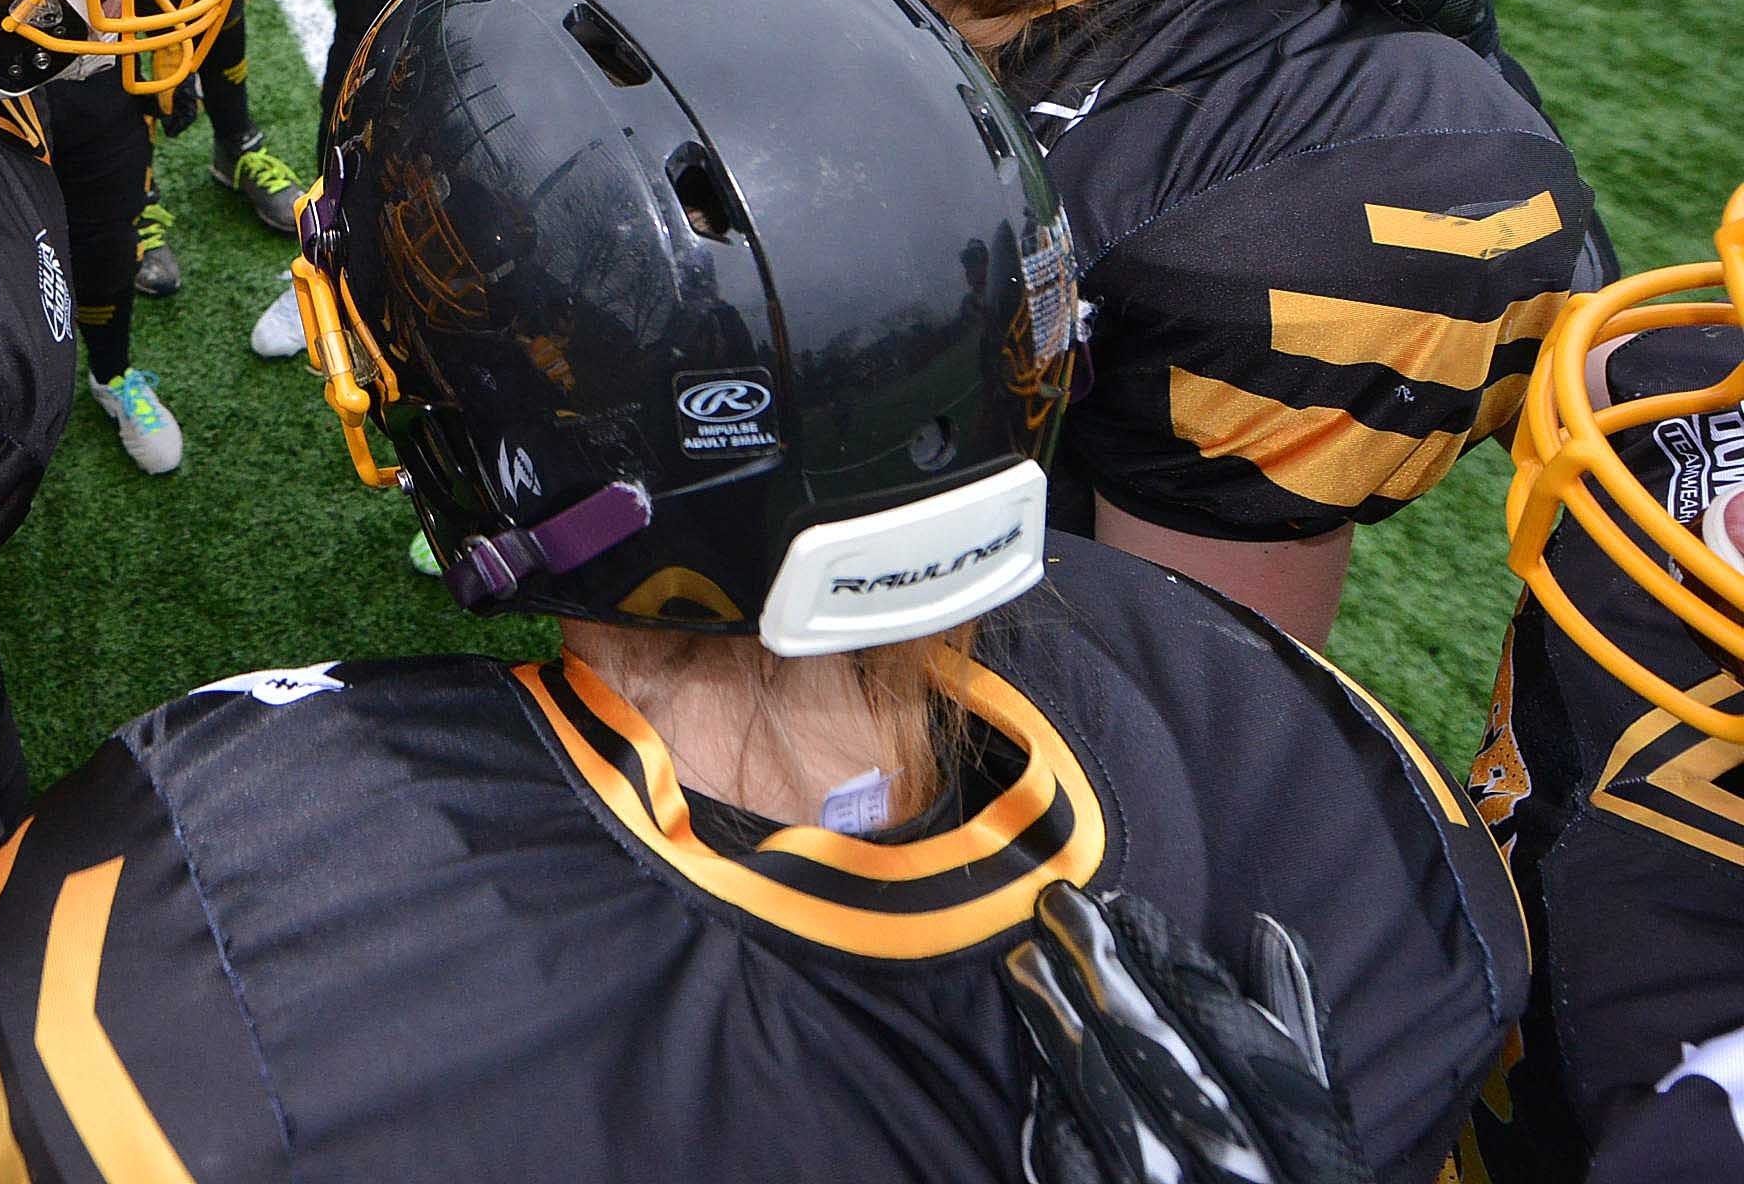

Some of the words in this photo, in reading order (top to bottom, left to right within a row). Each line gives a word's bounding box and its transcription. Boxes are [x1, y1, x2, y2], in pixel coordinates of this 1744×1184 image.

[697, 421, 759, 437] IMPULSE
[683, 436, 728, 449] ADULT
[729, 431, 776, 447] SMALL
[831, 520, 1024, 595] RAWLINGS
